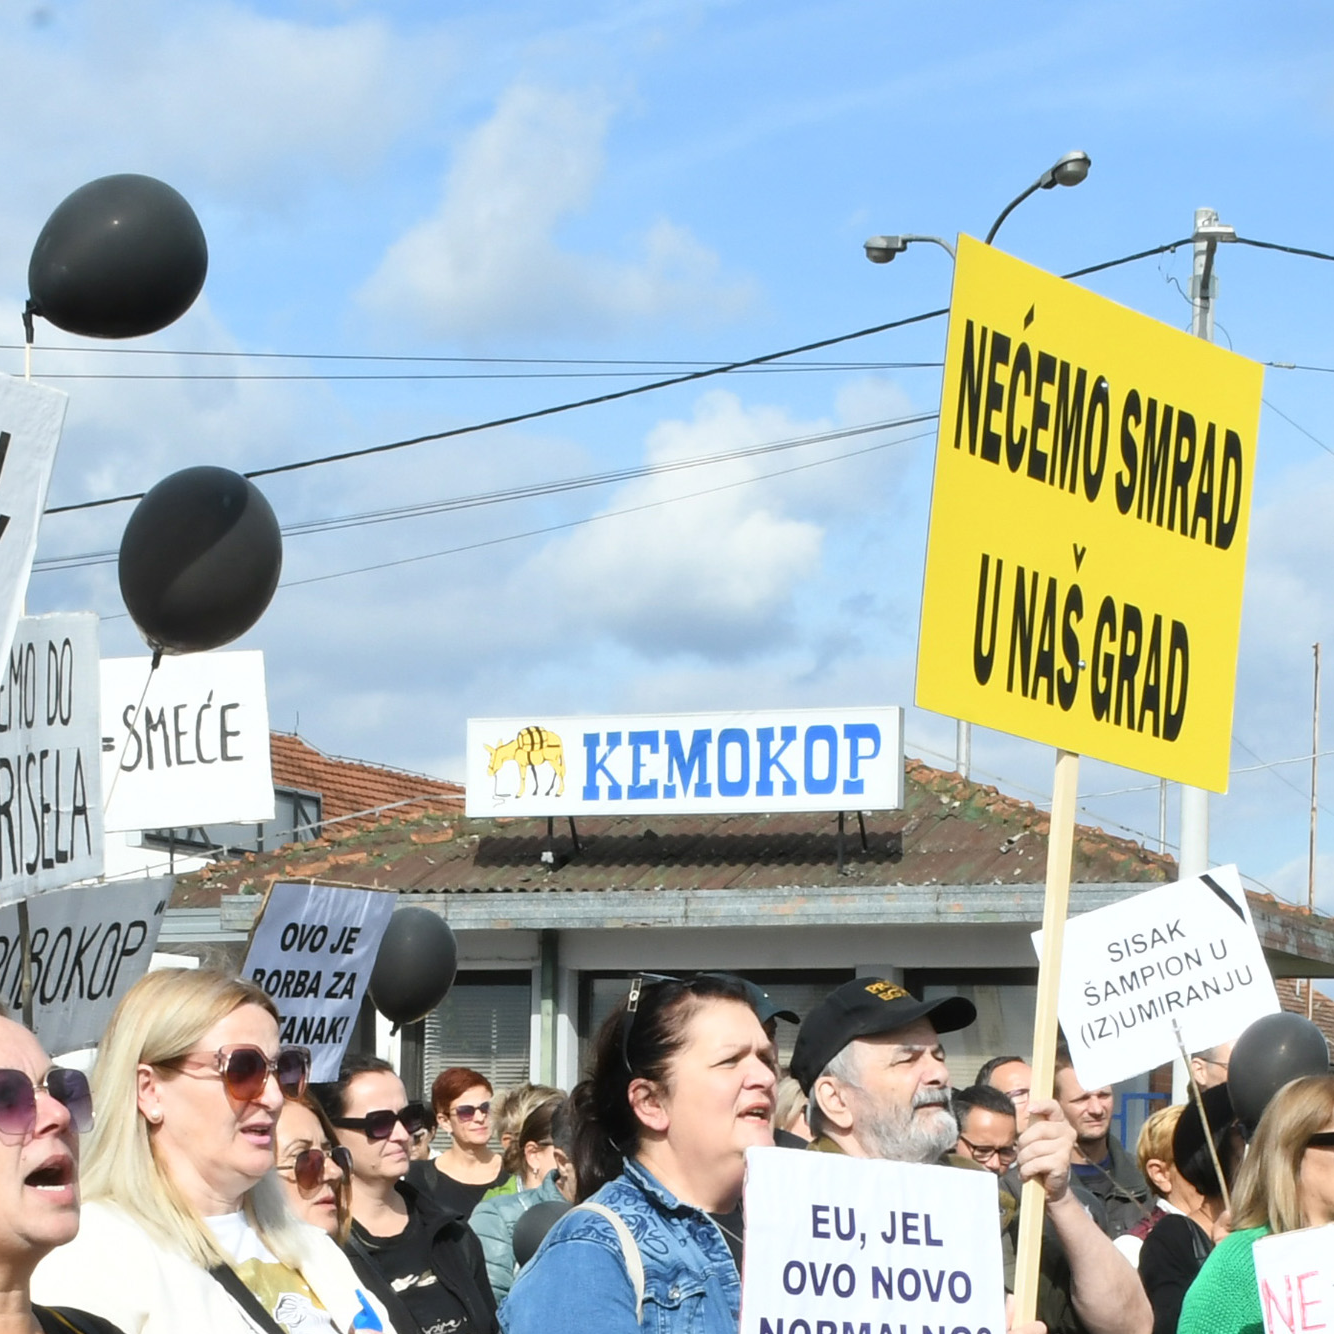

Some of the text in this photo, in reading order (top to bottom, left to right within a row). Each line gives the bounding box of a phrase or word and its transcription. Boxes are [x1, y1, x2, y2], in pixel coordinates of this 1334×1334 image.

[953, 303, 1243, 551] NEĆEMO SMRAD
[973, 542, 1190, 742] U NAŠ GRAD
[47, 637, 73, 727] DO
[582, 722, 882, 801] KEMOKOP
[280, 922, 362, 955] OVO JE
[1107, 919, 1186, 963] SISAK
[324, 971, 357, 999] ZA
[1080, 965, 1253, 1049] (IZ)UMIRANJU
[1084, 939, 1228, 1007] ŠAMPION U
[811, 1204, 944, 1250] EU, JEL
[783, 1260, 972, 1304] OVO NOVO
